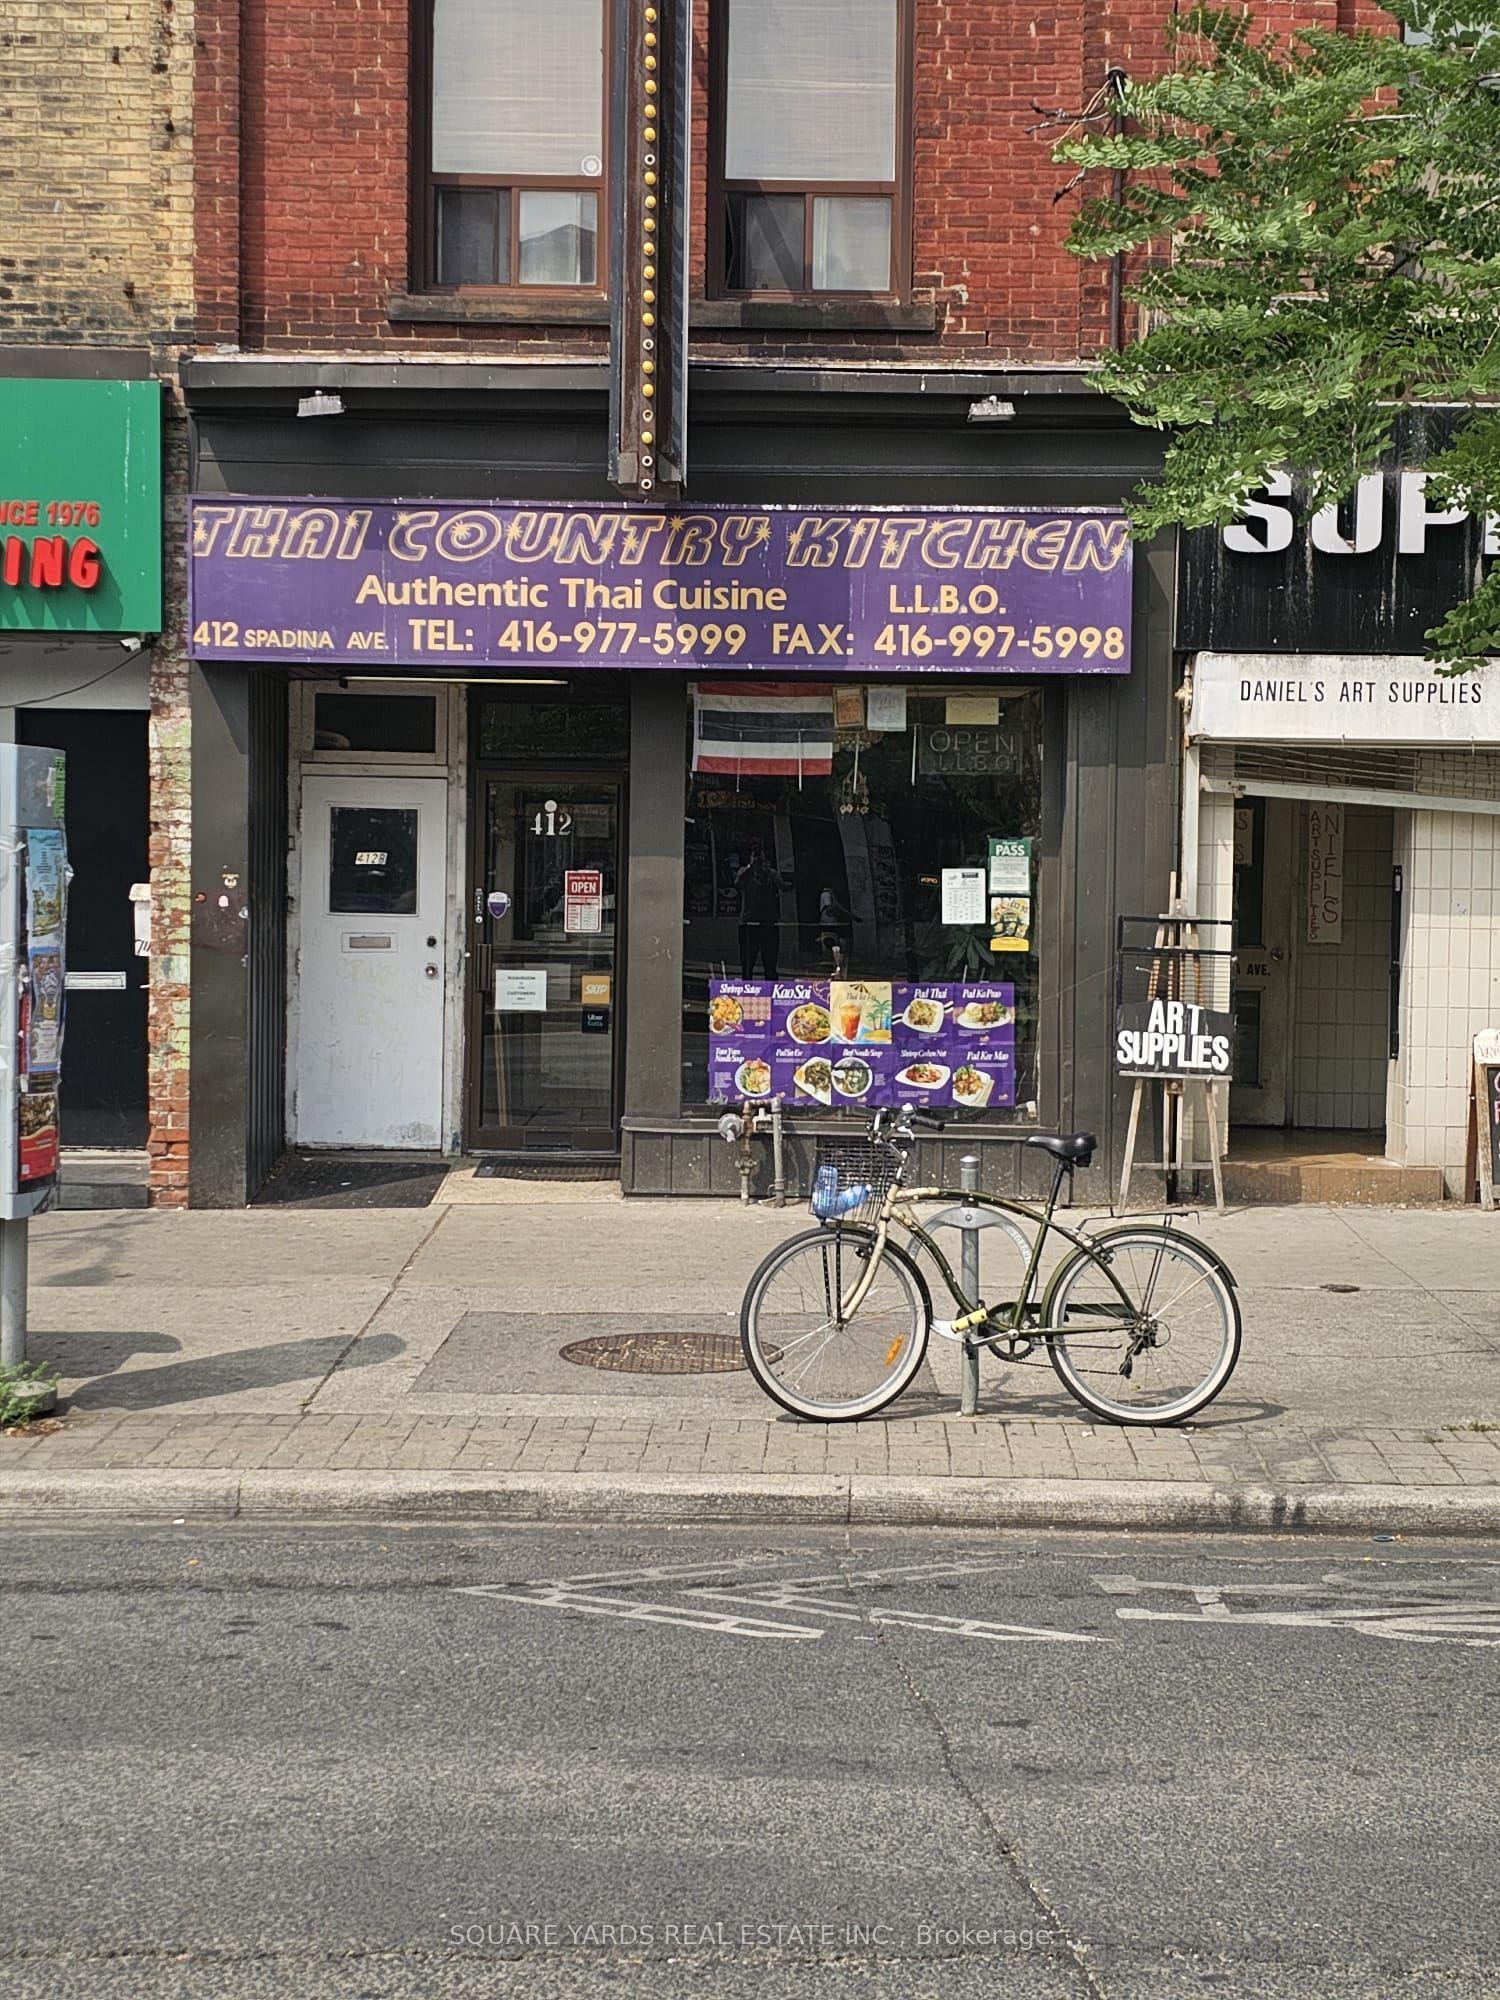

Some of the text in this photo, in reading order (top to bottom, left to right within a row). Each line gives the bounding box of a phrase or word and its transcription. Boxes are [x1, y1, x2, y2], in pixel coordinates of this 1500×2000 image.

[47, 501, 100, 527] 1976
[193, 506, 1129, 572] THAI COUNTRY KITCHEN
[4, 535, 101, 589] ING
[356, 574, 787, 611] Authentic Thai Cuisine
[889, 584, 1006, 615] L.L.B.O.
[193, 621, 389, 650] 412 SPADINA AVE.
[408, 619, 747, 656] TEL: 416-977-5999
[772, 623, 1124, 660] FAX: 416-997-5998
[1240, 680, 1482, 704] DANIEL'S ART SUPPLIES
[929, 730, 1014, 753] OPEN
[530, 811, 572, 836] 412
[995, 844, 1026, 857] PASS
[571, 881, 597, 894] OPEN
[1246, 963, 1271, 976] AVE.
[772, 984, 812, 1000] Kao Soi
[1147, 997, 1205, 1036] ART
[1116, 1029, 1230, 1073] SUPPLIES
